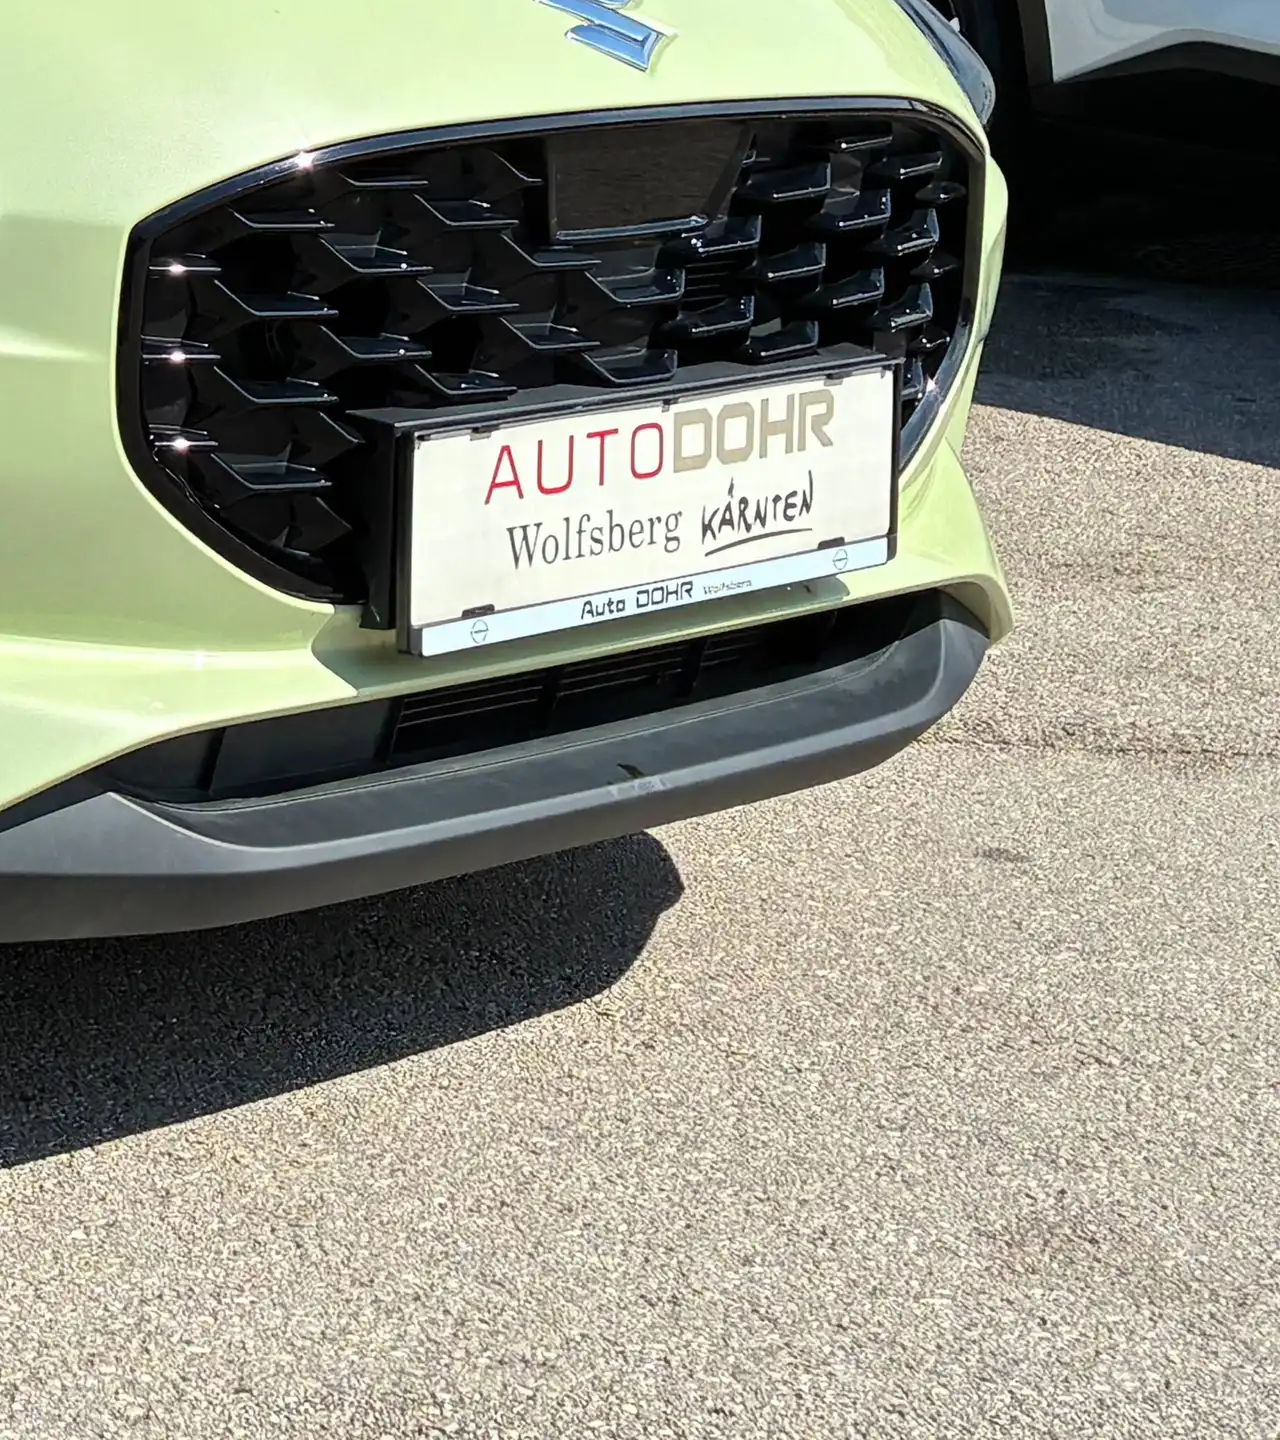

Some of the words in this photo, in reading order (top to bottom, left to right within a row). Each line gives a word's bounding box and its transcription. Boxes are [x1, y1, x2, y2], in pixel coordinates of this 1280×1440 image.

[506, 510, 683, 571] Wolfsberg
[580, 597, 626, 620] Auto
[636, 580, 694, 610] DOHR
